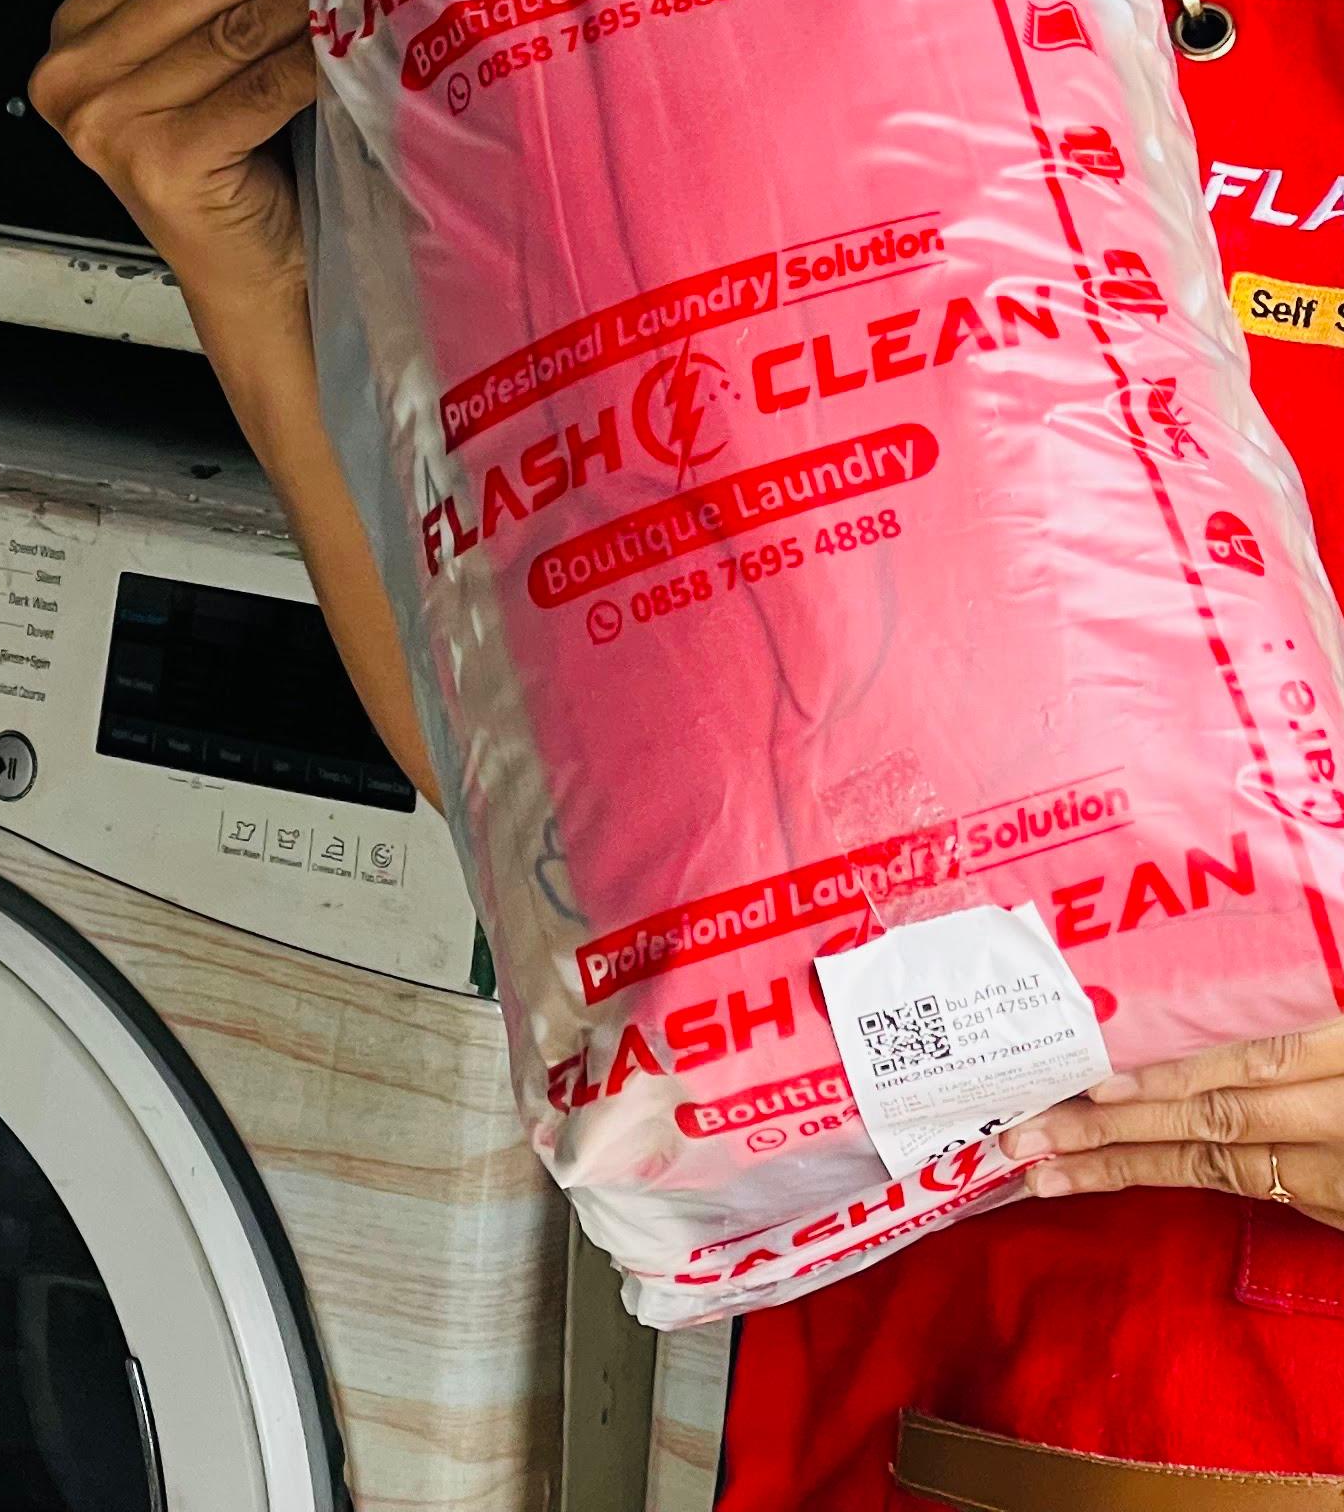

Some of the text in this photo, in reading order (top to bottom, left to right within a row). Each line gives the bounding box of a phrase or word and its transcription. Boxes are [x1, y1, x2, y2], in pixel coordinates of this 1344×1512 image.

[477, 35, 553, 90] 0858
[560, 4, 642, 53] 7695
[445, 225, 945, 437] Profesional Laundry Solution
[1251, 289, 1318, 329] Self
[422, 284, 1061, 578] FLASH CLEAN
[8, 539, 38, 556] Speed
[544, 435, 916, 593] Boutique Laundry
[8, 591, 29, 607] Dark
[629, 508, 901, 625] 0858 7695 4888
[588, 785, 1132, 988] Profesional Laundry Solution
[1054, 833, 1258, 951] EAN
[946, 999, 969, 1013] bu
[1012, 974, 1042, 993] JLT
[958, 1028, 990, 1048] 594
[695, 1073, 849, 1134] Boutiq
